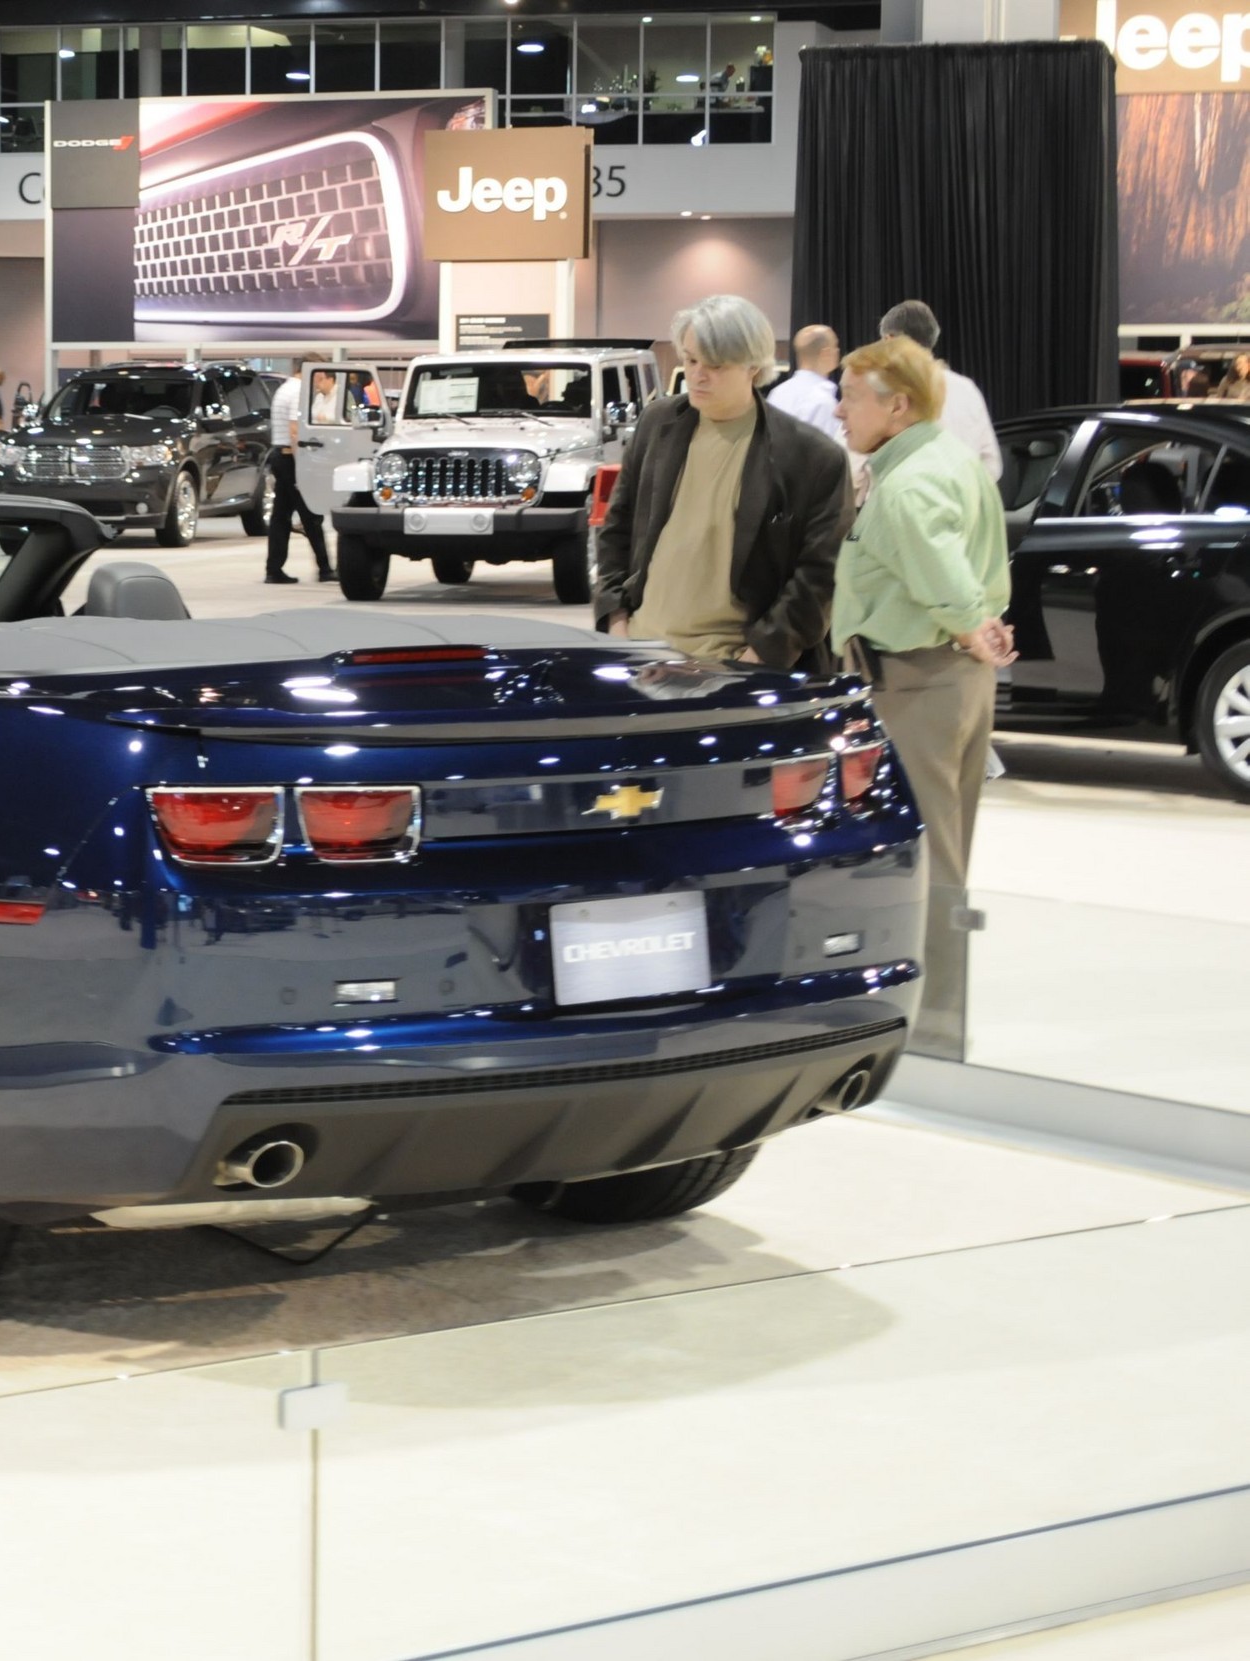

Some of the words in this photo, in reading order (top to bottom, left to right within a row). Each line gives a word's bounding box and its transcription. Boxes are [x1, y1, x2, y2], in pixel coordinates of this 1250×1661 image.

[53, 139, 123, 148] DODGE
[18, 172, 45, 204] C
[437, 166, 567, 220] Jeep
[270, 213, 353, 266] R/T
[563, 931, 697, 963] CHEVROLET
